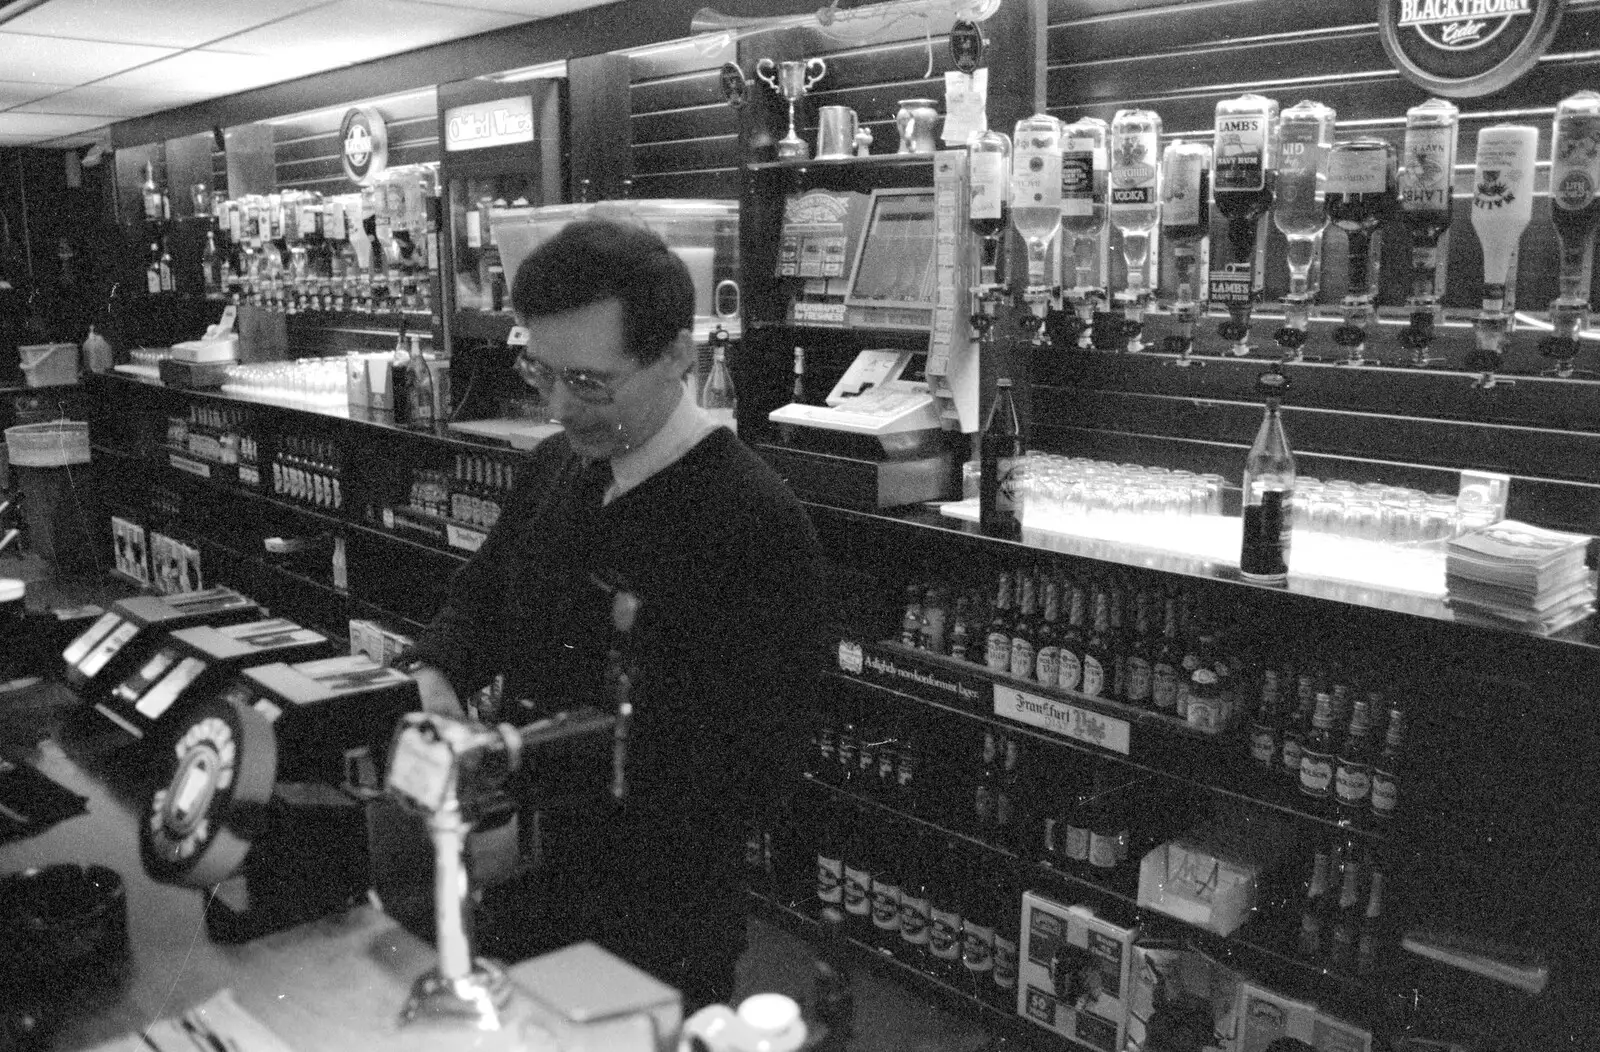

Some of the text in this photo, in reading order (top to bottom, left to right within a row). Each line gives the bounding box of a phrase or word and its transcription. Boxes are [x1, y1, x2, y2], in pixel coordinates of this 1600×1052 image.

[1442, 20, 1487, 43] Cider
[1218, 120, 1259, 132] LAMB'S
[1282, 143, 1305, 155] GIN
[1217, 156, 1258, 165] NAVY RUM
[1113, 190, 1145, 201] VODKA
[1211, 282, 1249, 293] LAMB'S
